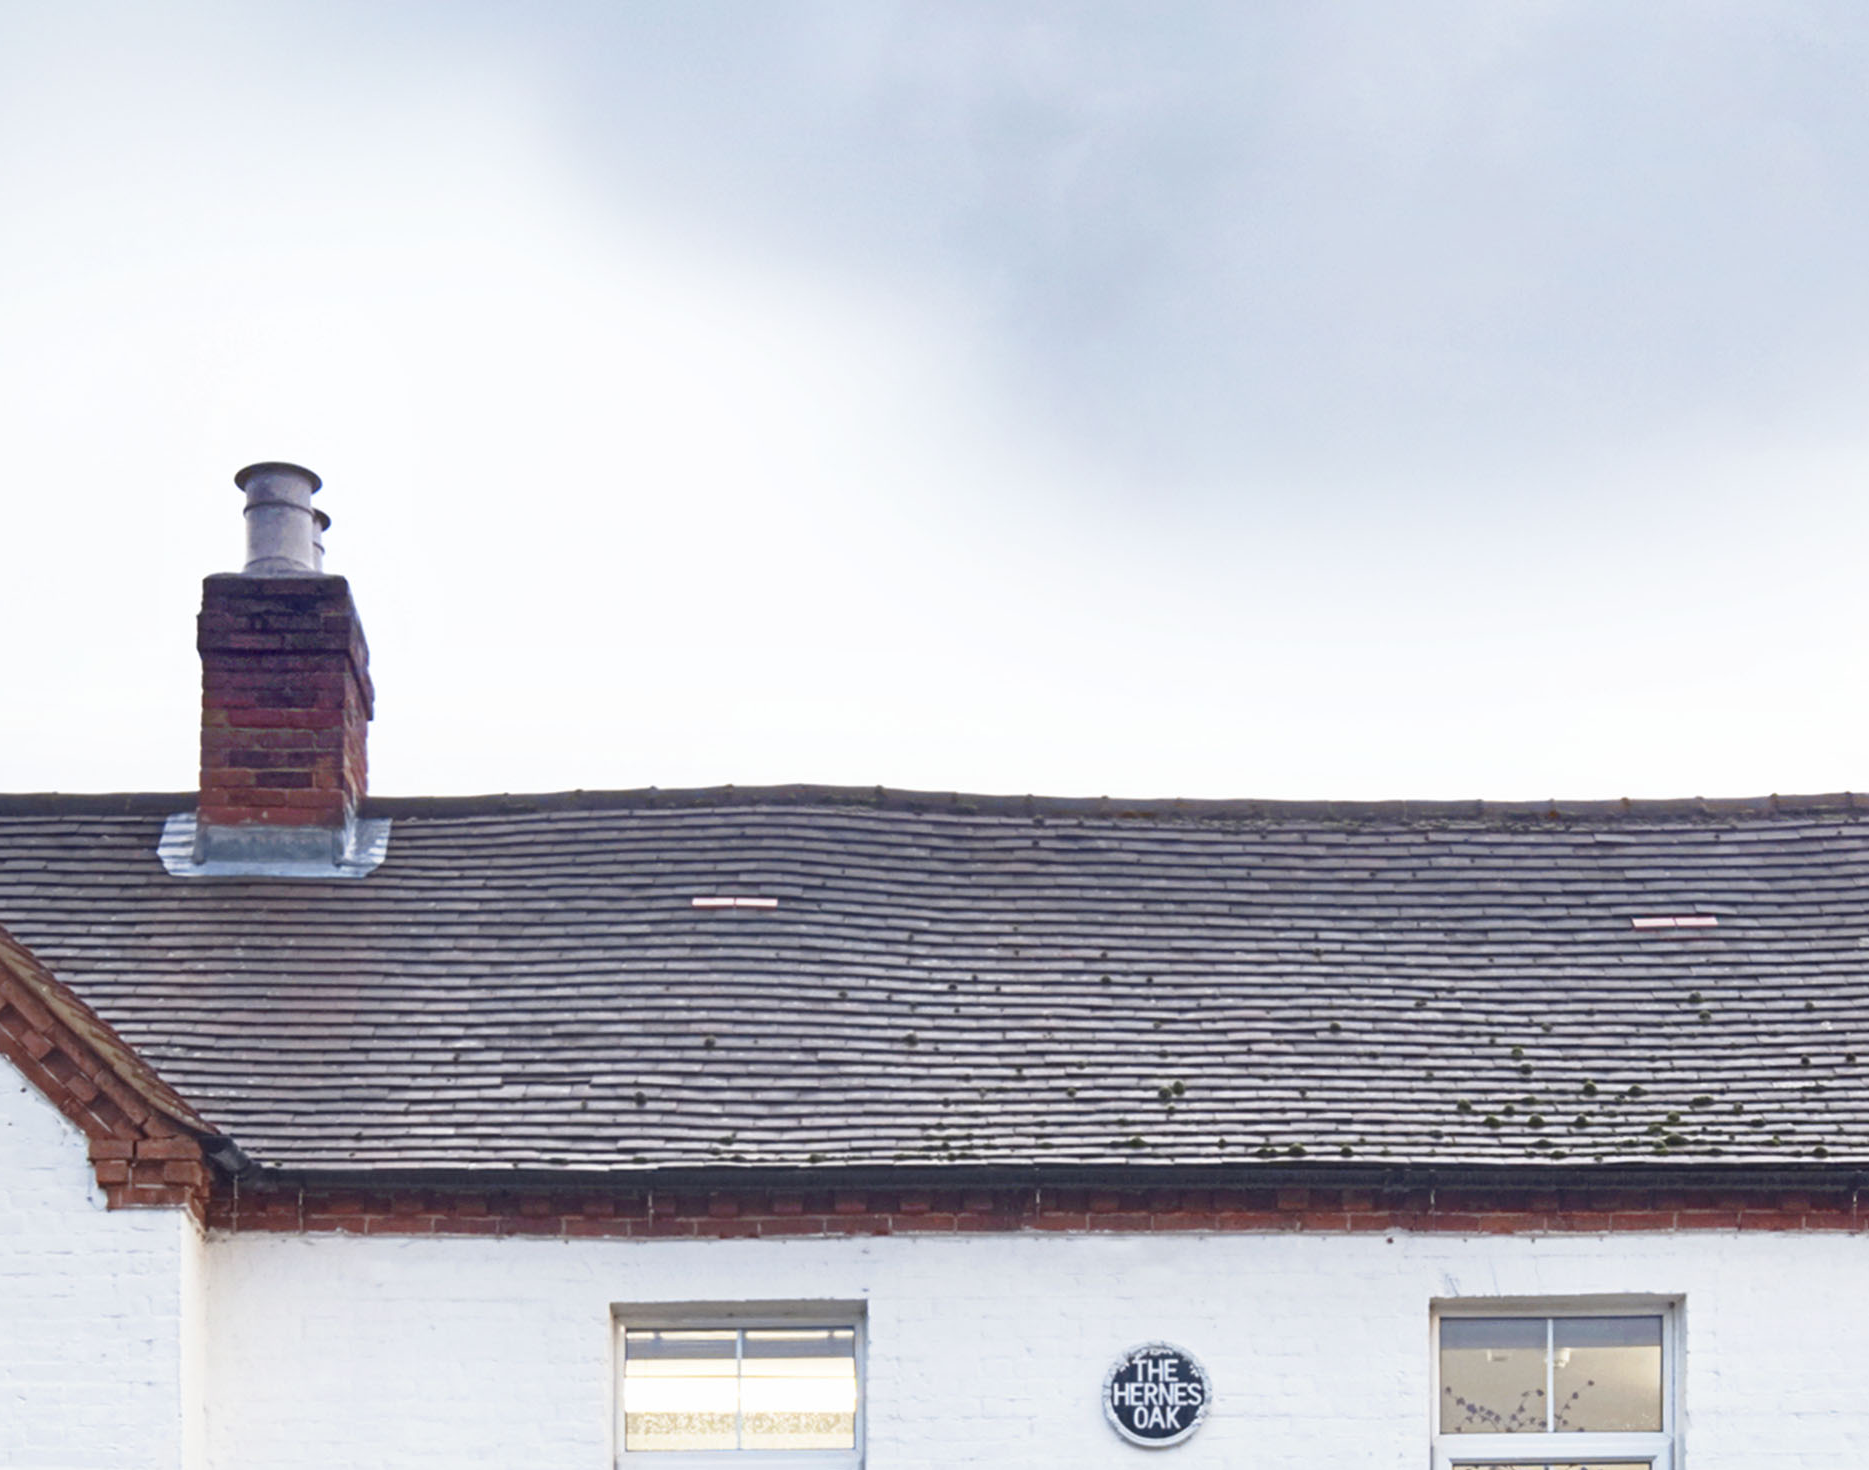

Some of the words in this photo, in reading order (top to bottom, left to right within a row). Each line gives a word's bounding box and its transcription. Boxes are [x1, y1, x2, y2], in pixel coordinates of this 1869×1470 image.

[1132, 1358, 1179, 1382] THE
[1113, 1381, 1203, 1406] HERNES
[1133, 1406, 1181, 1429] OAK
